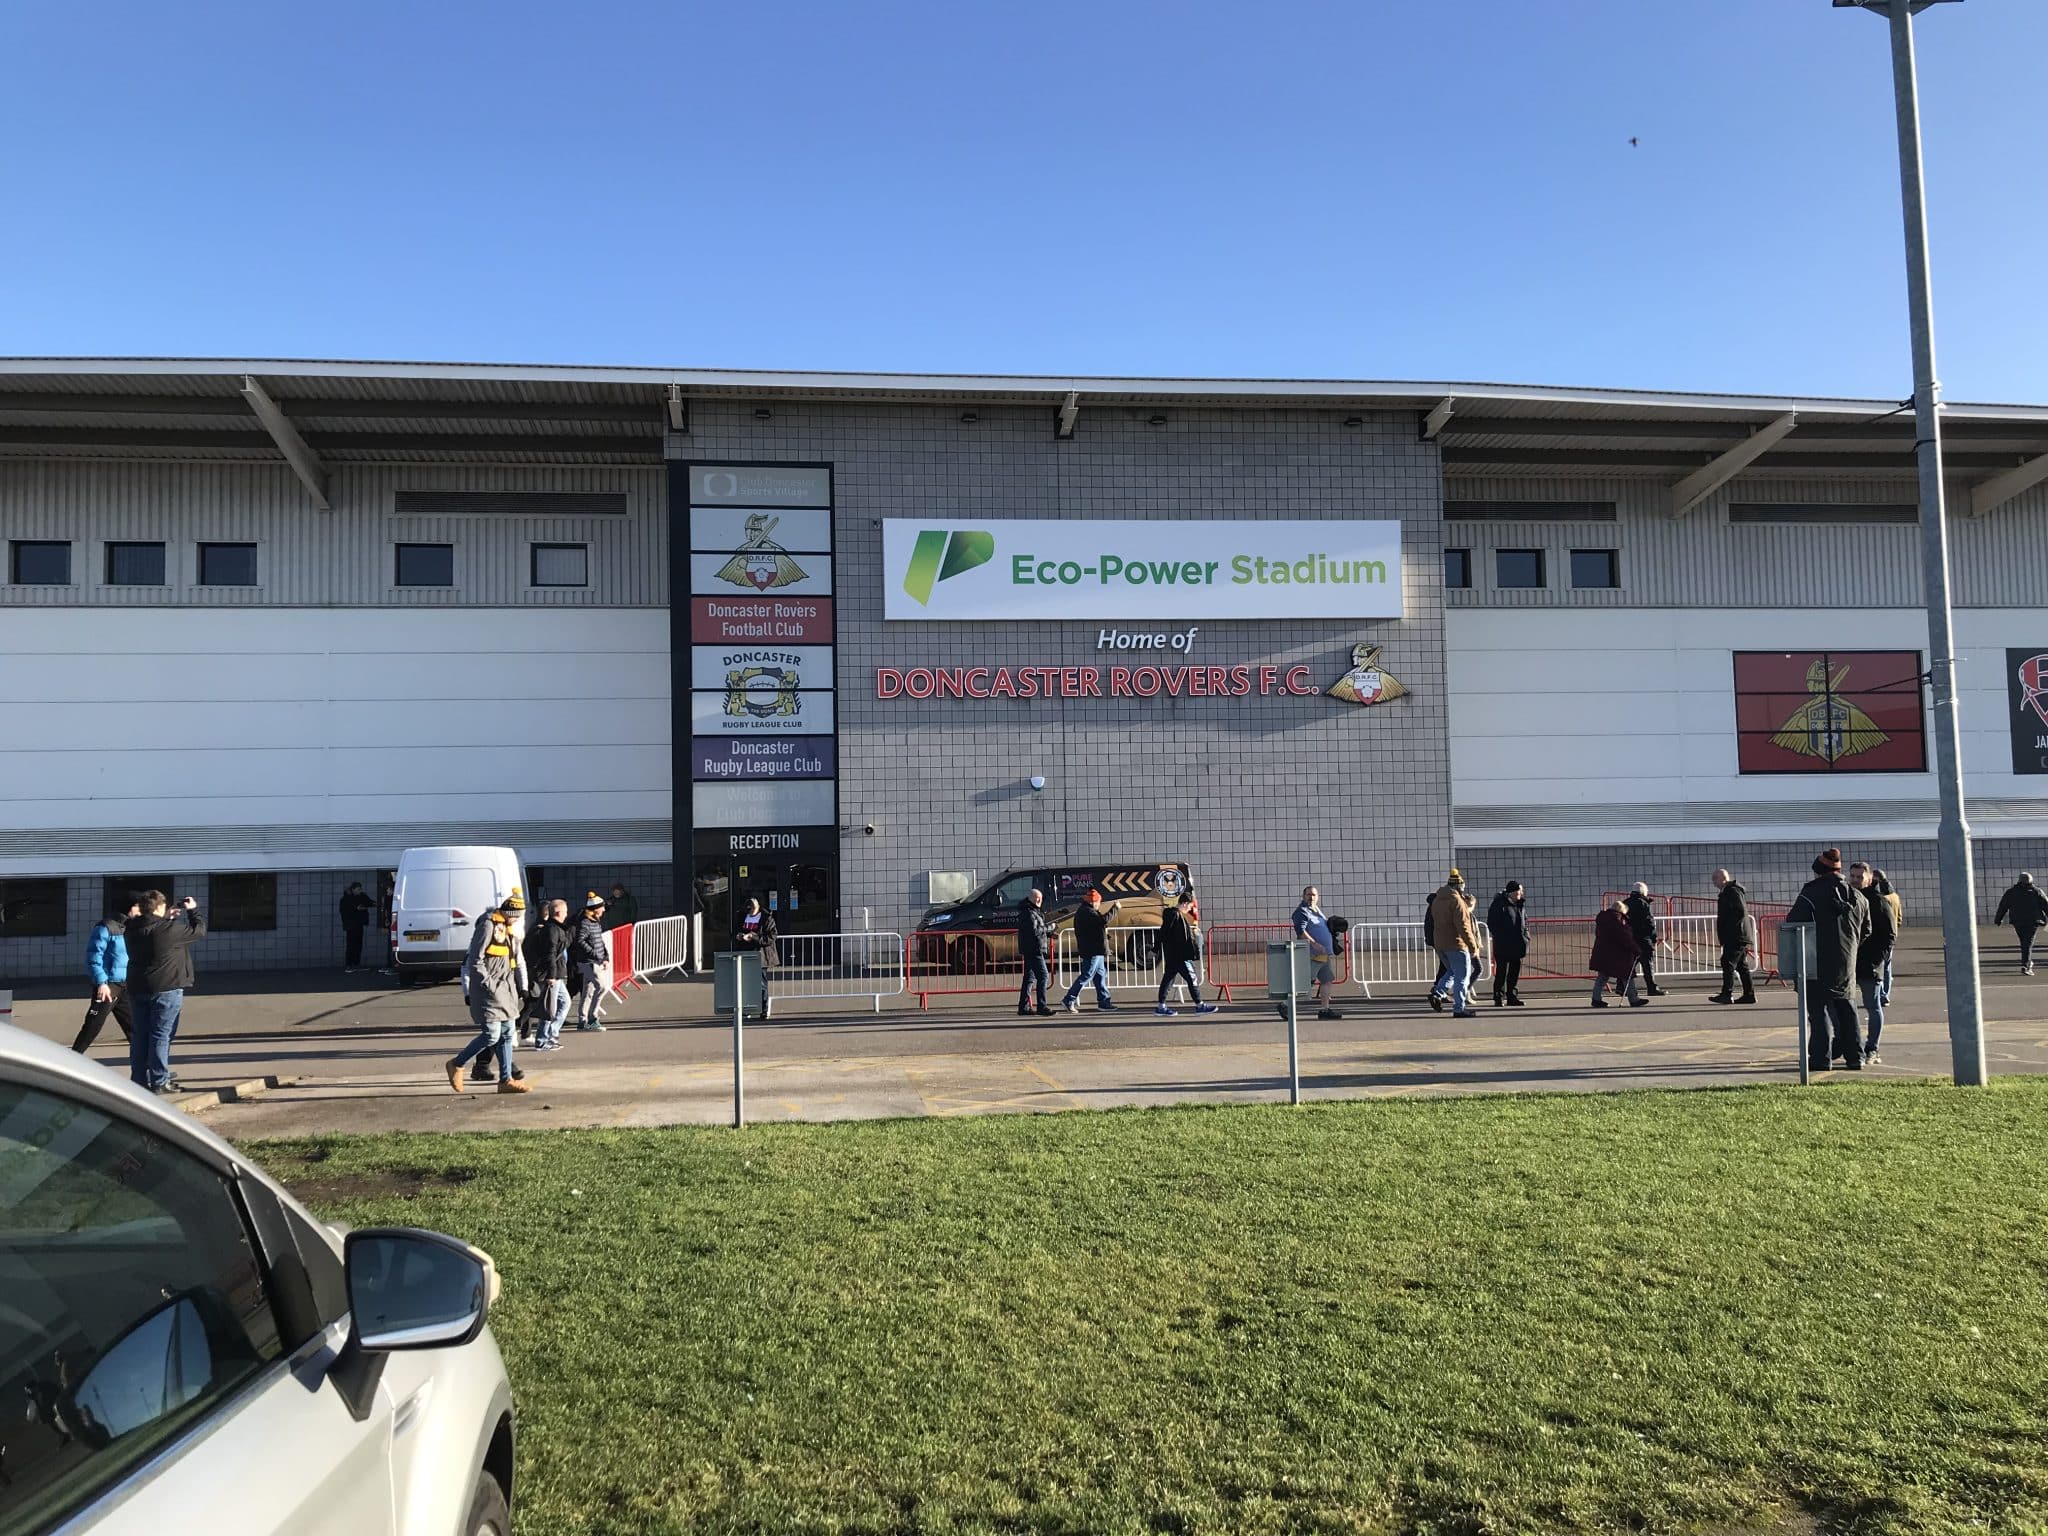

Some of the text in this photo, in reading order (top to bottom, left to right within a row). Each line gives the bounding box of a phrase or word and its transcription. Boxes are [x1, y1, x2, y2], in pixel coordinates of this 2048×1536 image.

[1011, 552, 1387, 585] Eco-Power Stadium
[708, 603, 817, 618] Doncaster Rovers
[722, 622, 804, 637] Football Club
[1097, 627, 1199, 654] Home of
[722, 651, 802, 667] DONCASTER
[876, 665, 1319, 699] DONCASTER ROVERS F.C.
[731, 741, 795, 755] Doncaster
[704, 757, 822, 776] Rugby League Club
[730, 834, 800, 850] RECEPTION
